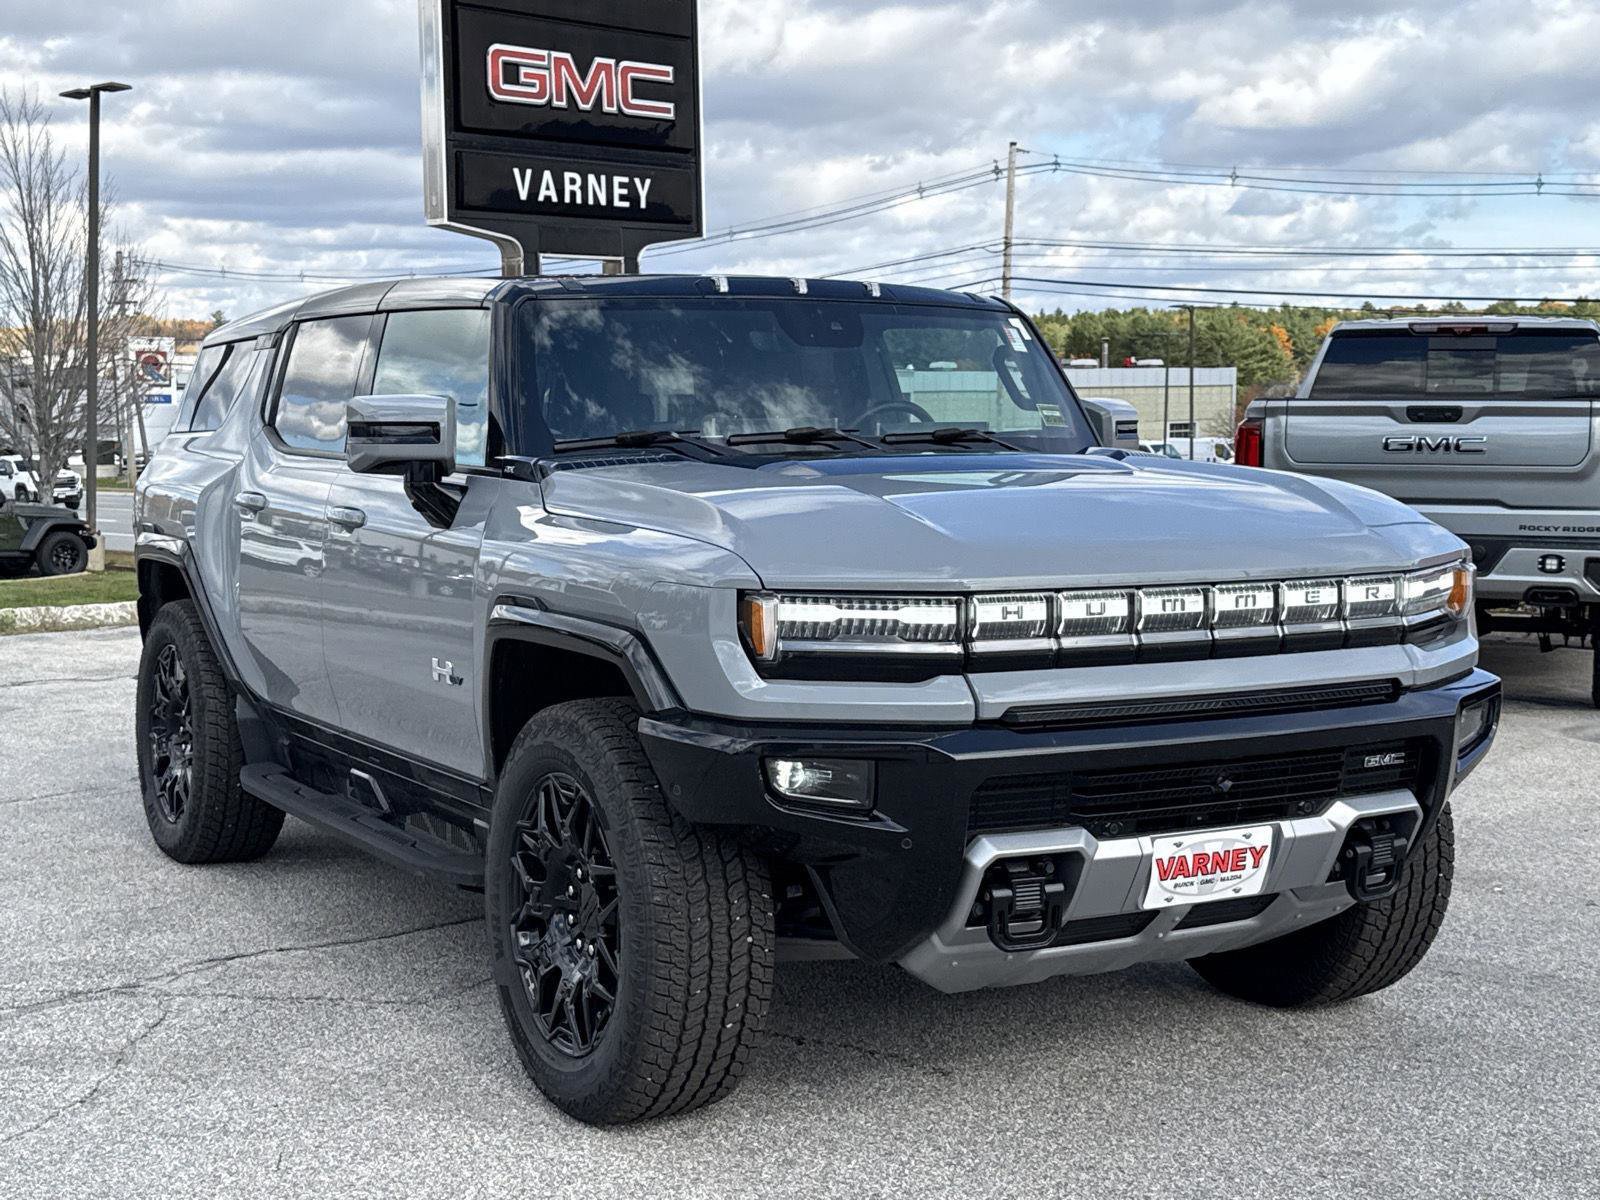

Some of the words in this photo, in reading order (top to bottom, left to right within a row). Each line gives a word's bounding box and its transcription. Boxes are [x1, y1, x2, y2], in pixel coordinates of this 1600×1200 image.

[487, 43, 675, 119] GMC
[513, 167, 651, 209] VARNEY
[1382, 435, 1487, 454] GMC
[1519, 524, 1560, 532] ROCKY
[1002, 586, 1380, 620] HUMMER
[1364, 752, 1405, 768] GMC
[1156, 845, 1268, 881] VARNEY
[1173, 881, 1195, 889] BUICK
[1200, 878, 1215, 886] GMC
